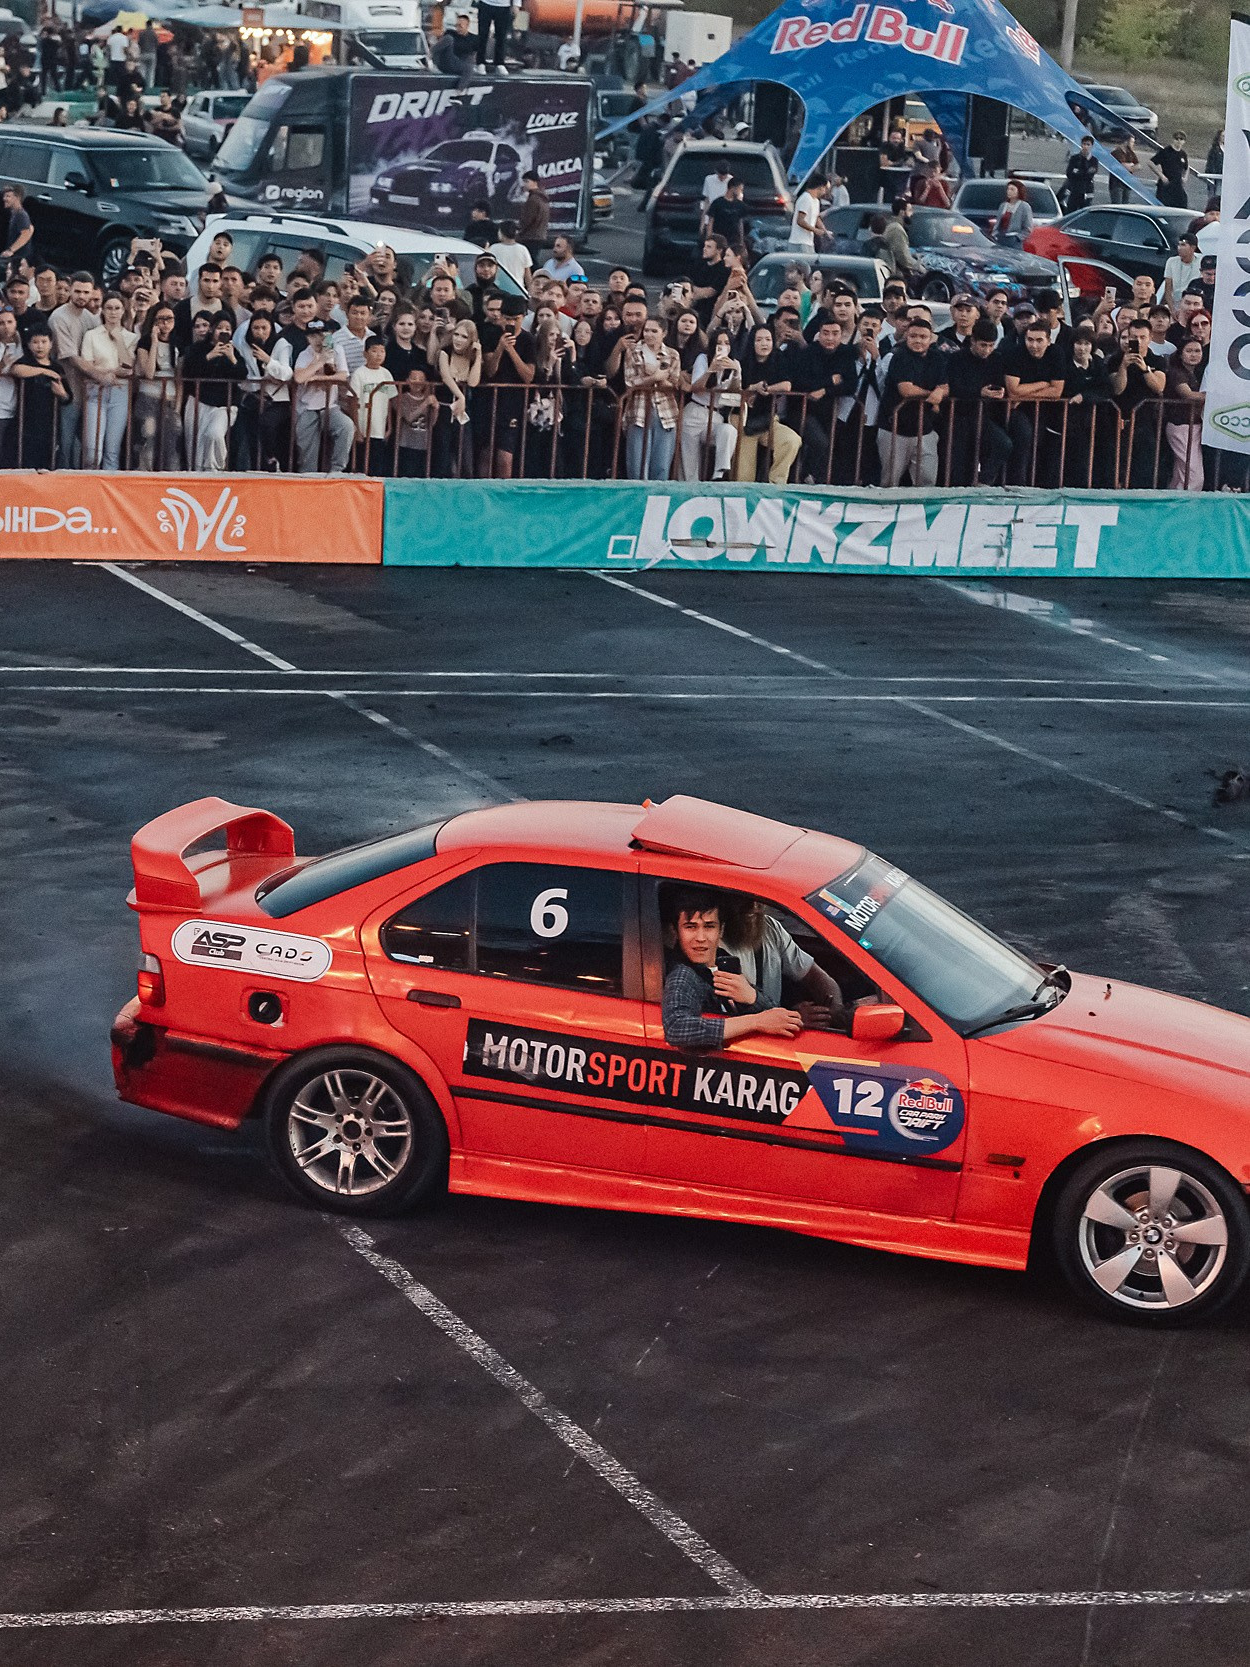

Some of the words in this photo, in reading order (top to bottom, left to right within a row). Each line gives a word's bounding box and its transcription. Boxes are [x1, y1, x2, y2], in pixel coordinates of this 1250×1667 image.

[770, 4, 870, 55] Red
[865, 5, 969, 65] Bull
[367, 86, 494, 124] DRIFT
[526, 113, 559, 128] LOW
[558, 111, 579, 125] KZ
[280, 186, 324, 202] region
[635, 495, 1119, 568] LOWKZMEET
[529, 888, 569, 938] 6
[193, 930, 246, 948] ASP
[482, 1032, 687, 1098] MOTORSPORT
[693, 1067, 813, 1117] KARAG
[833, 1078, 884, 1118] 12
[898, 1093, 926, 1109] Red
[926, 1096, 953, 1113] Bull
[898, 1116, 946, 1130] DRIFT
[919, 1111, 947, 1120] PARK
